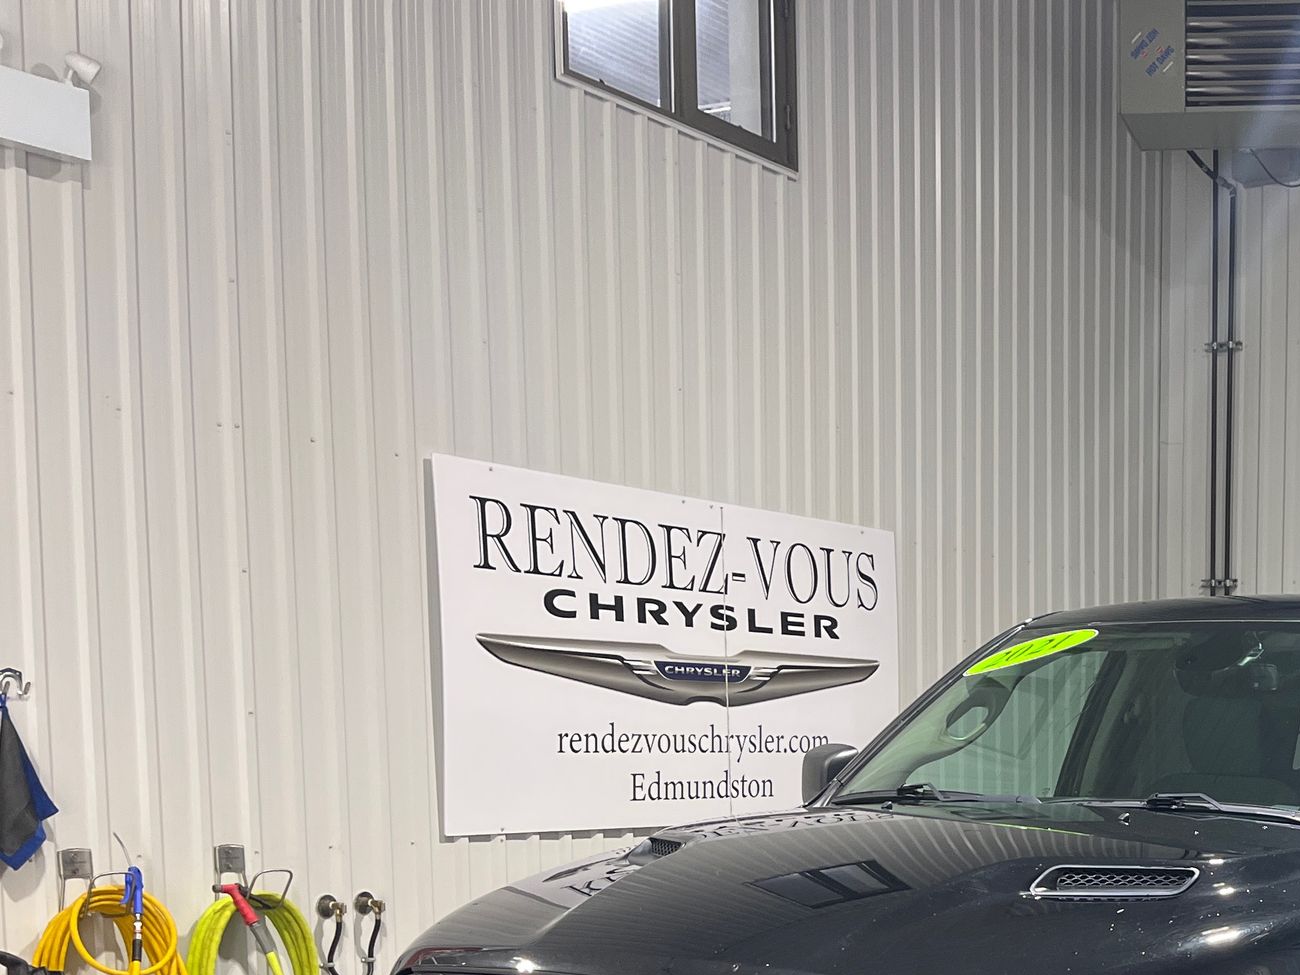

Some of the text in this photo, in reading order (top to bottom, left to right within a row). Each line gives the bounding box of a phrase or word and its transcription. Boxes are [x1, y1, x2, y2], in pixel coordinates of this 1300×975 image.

[469, 495, 878, 611] RENDEZ-VOUS
[543, 588, 840, 640] CHRYSLER
[983, 633, 1073, 670] 2021
[664, 665, 741, 678] CHRYSLER
[557, 722, 829, 763] rendezvouschrysler.com
[630, 770, 774, 802] Edmundston
